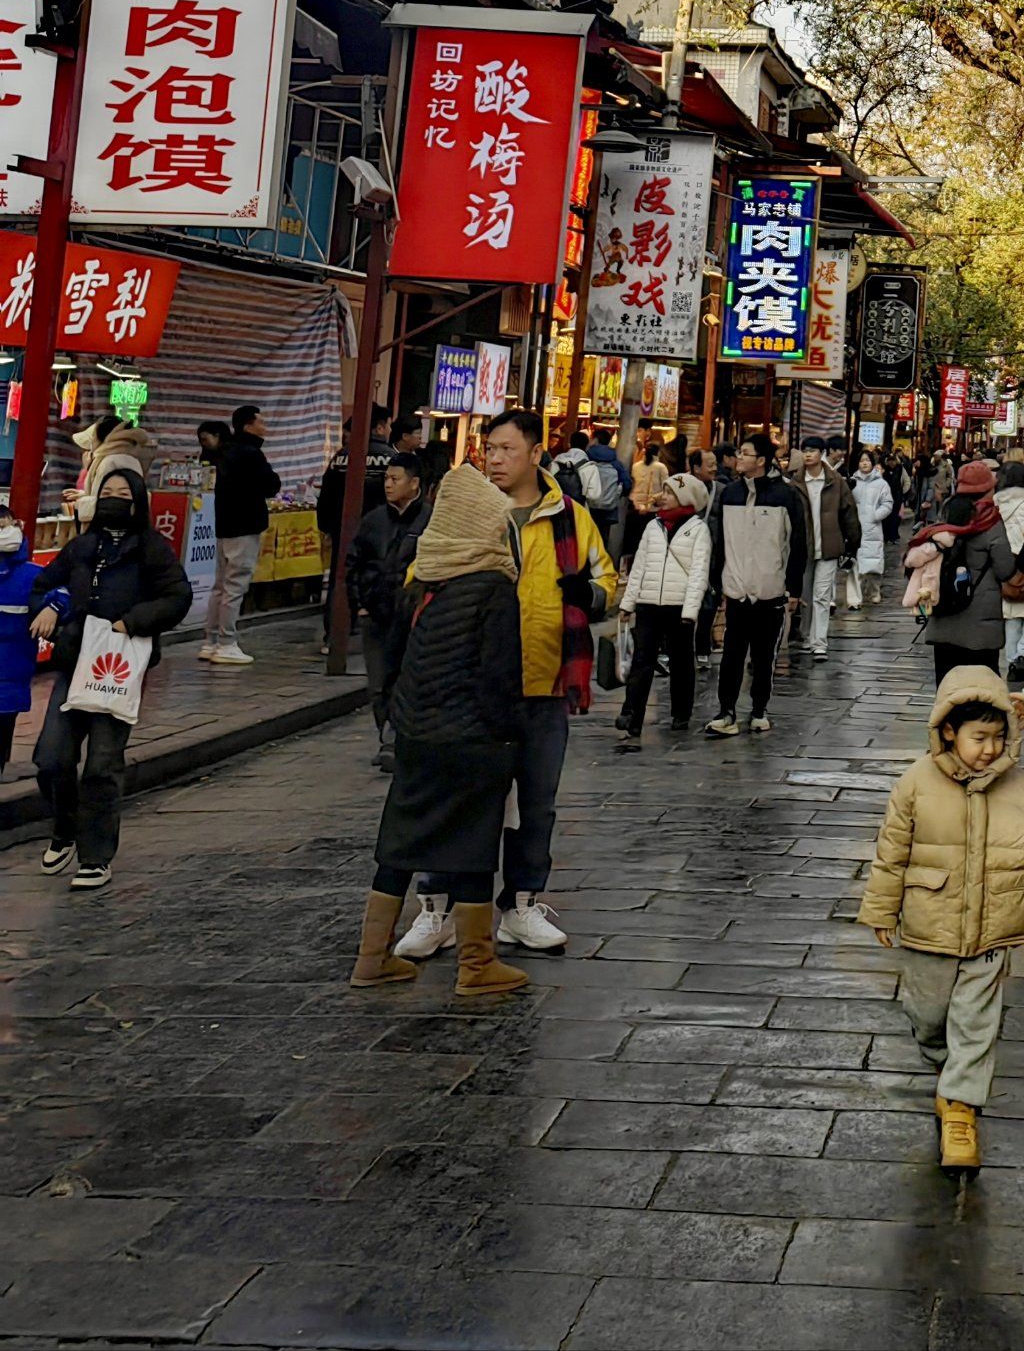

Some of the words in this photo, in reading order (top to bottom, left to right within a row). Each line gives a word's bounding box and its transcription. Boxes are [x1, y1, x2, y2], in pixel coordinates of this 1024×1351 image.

[424, 41, 463, 149] 回坊记忆
[462, 58, 550, 251] 酸梅汤
[620, 173, 676, 317] 皮影戏
[733, 220, 802, 335] 肉夹馍
[943, 368, 967, 428] 居住民宿
[85, 681, 128, 697] HUAWEI
